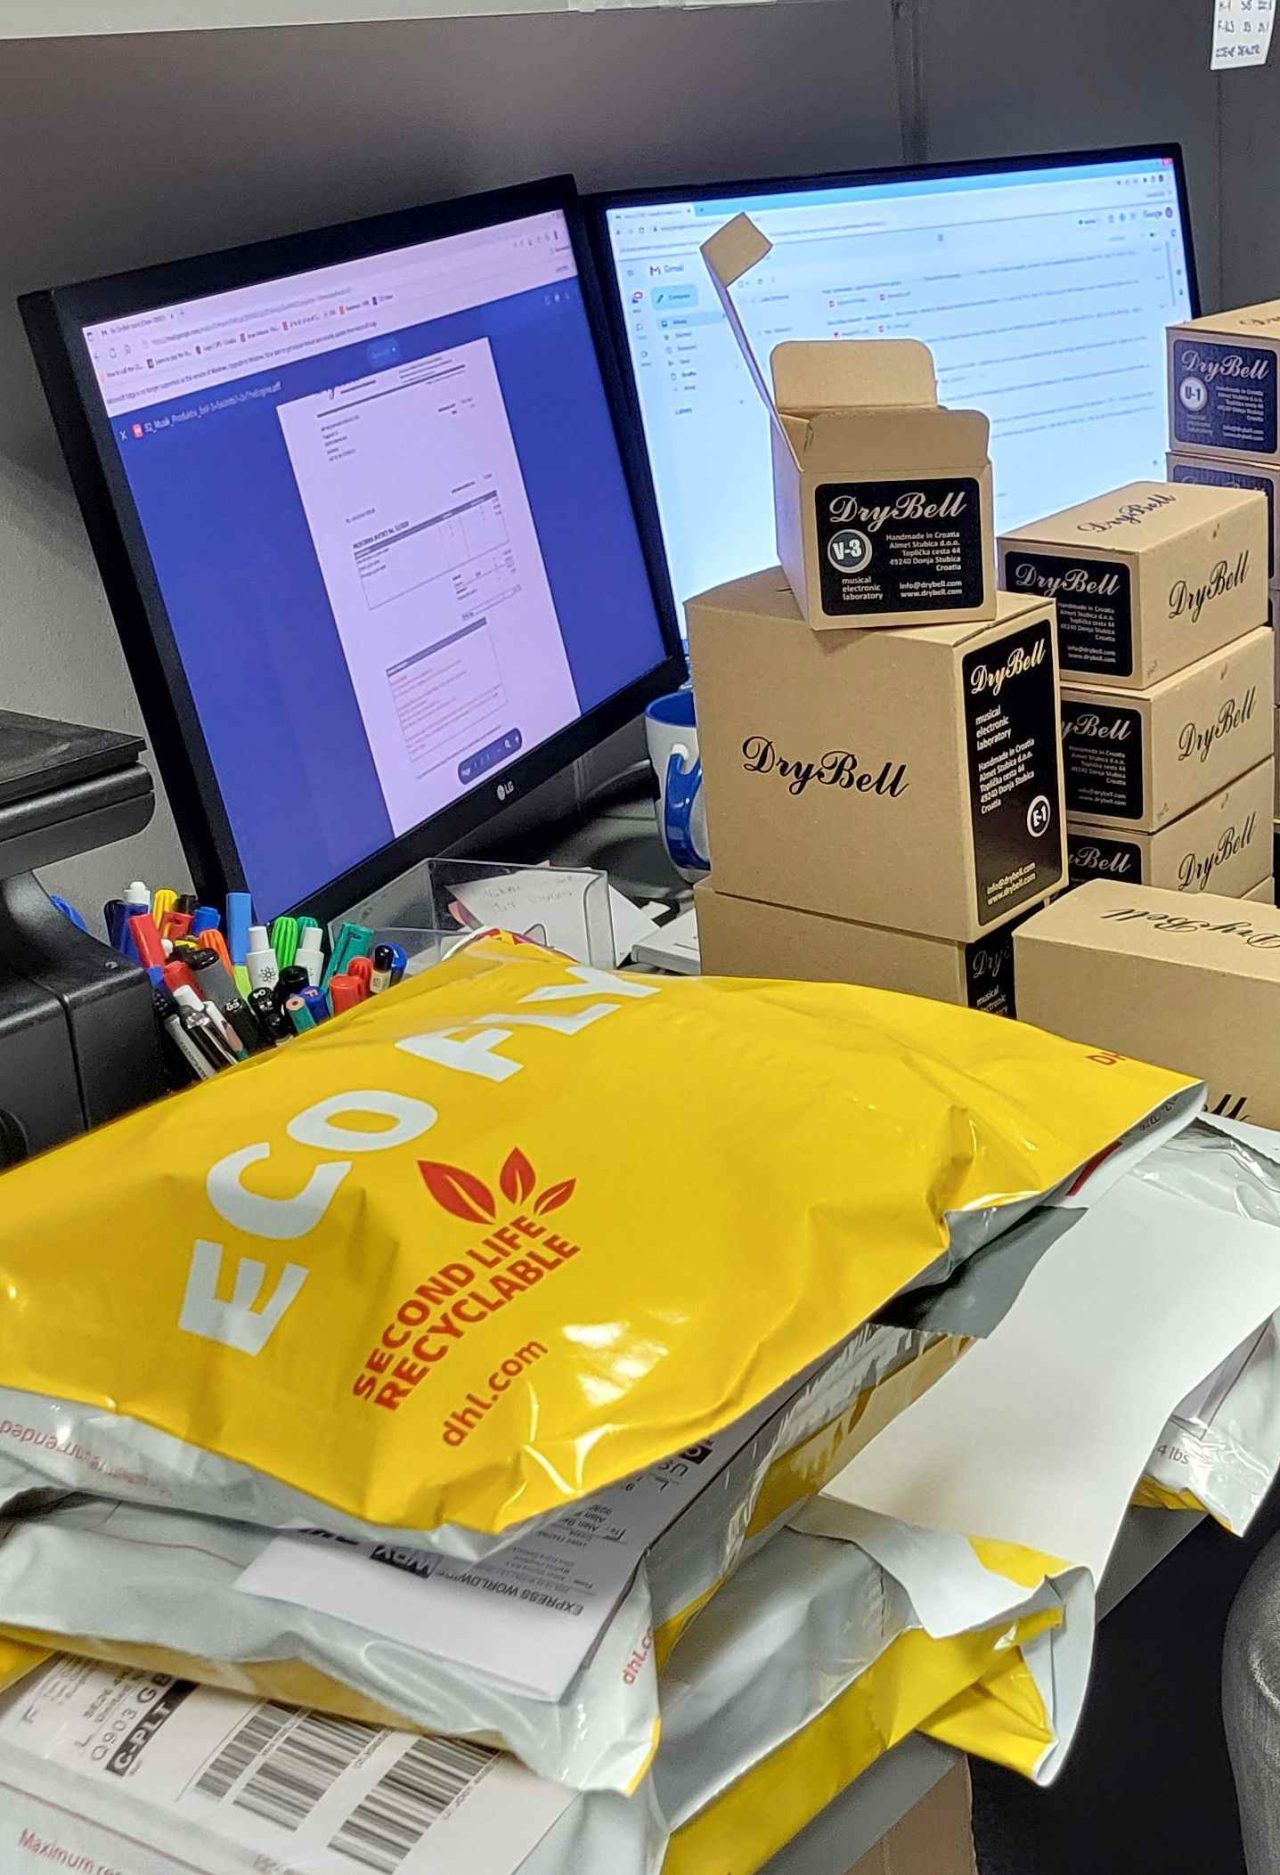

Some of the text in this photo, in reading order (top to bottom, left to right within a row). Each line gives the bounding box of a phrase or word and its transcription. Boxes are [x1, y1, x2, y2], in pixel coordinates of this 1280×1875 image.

[1181, 350, 1270, 383] DryBell
[1184, 385, 1201, 401] U-1
[829, 491, 967, 533] DryBell
[1077, 493, 1178, 533] DryBell
[886, 531, 960, 541] Handmade in Croatia
[912, 540, 939, 549] Stubica
[939, 539, 961, 547] d.o.o.
[832, 539, 862, 561] V-3
[912, 556, 934, 565] Donja
[935, 555, 961, 563] Stubica
[931, 548, 951, 556] cesta
[842, 576, 871, 584] musical
[842, 584, 881, 593] electronic
[899, 579, 962, 590] info@drybell.com
[1014, 562, 1121, 598] DryBell
[1168, 550, 1249, 623] DryBell
[843, 592, 883, 600] laboratory
[900, 588, 962, 598] www.drybell.com
[971, 638, 1047, 696] DryBell
[975, 704, 1001, 726] musical
[976, 716, 1009, 738] electronic
[1178, 686, 1256, 763] DryBell
[977, 728, 1012, 751] laboratory
[742, 735, 910, 797] DryBell
[1033, 805, 1047, 828] E-1
[1178, 811, 1256, 892] DryBell
[178, 965, 661, 1356] ECO FLY
[352, 1214, 547, 1401] SECOND LIFE
[374, 1232, 581, 1411] RECYCLABLE
[440, 1337, 549, 1448] dhl.com
[1169, 1446, 1189, 1465] lbs
[520, 1588, 584, 1616] EXPRESS
[113, 1702, 172, 1770] C-PLT
[18, 1828, 95, 1873] Maximum
